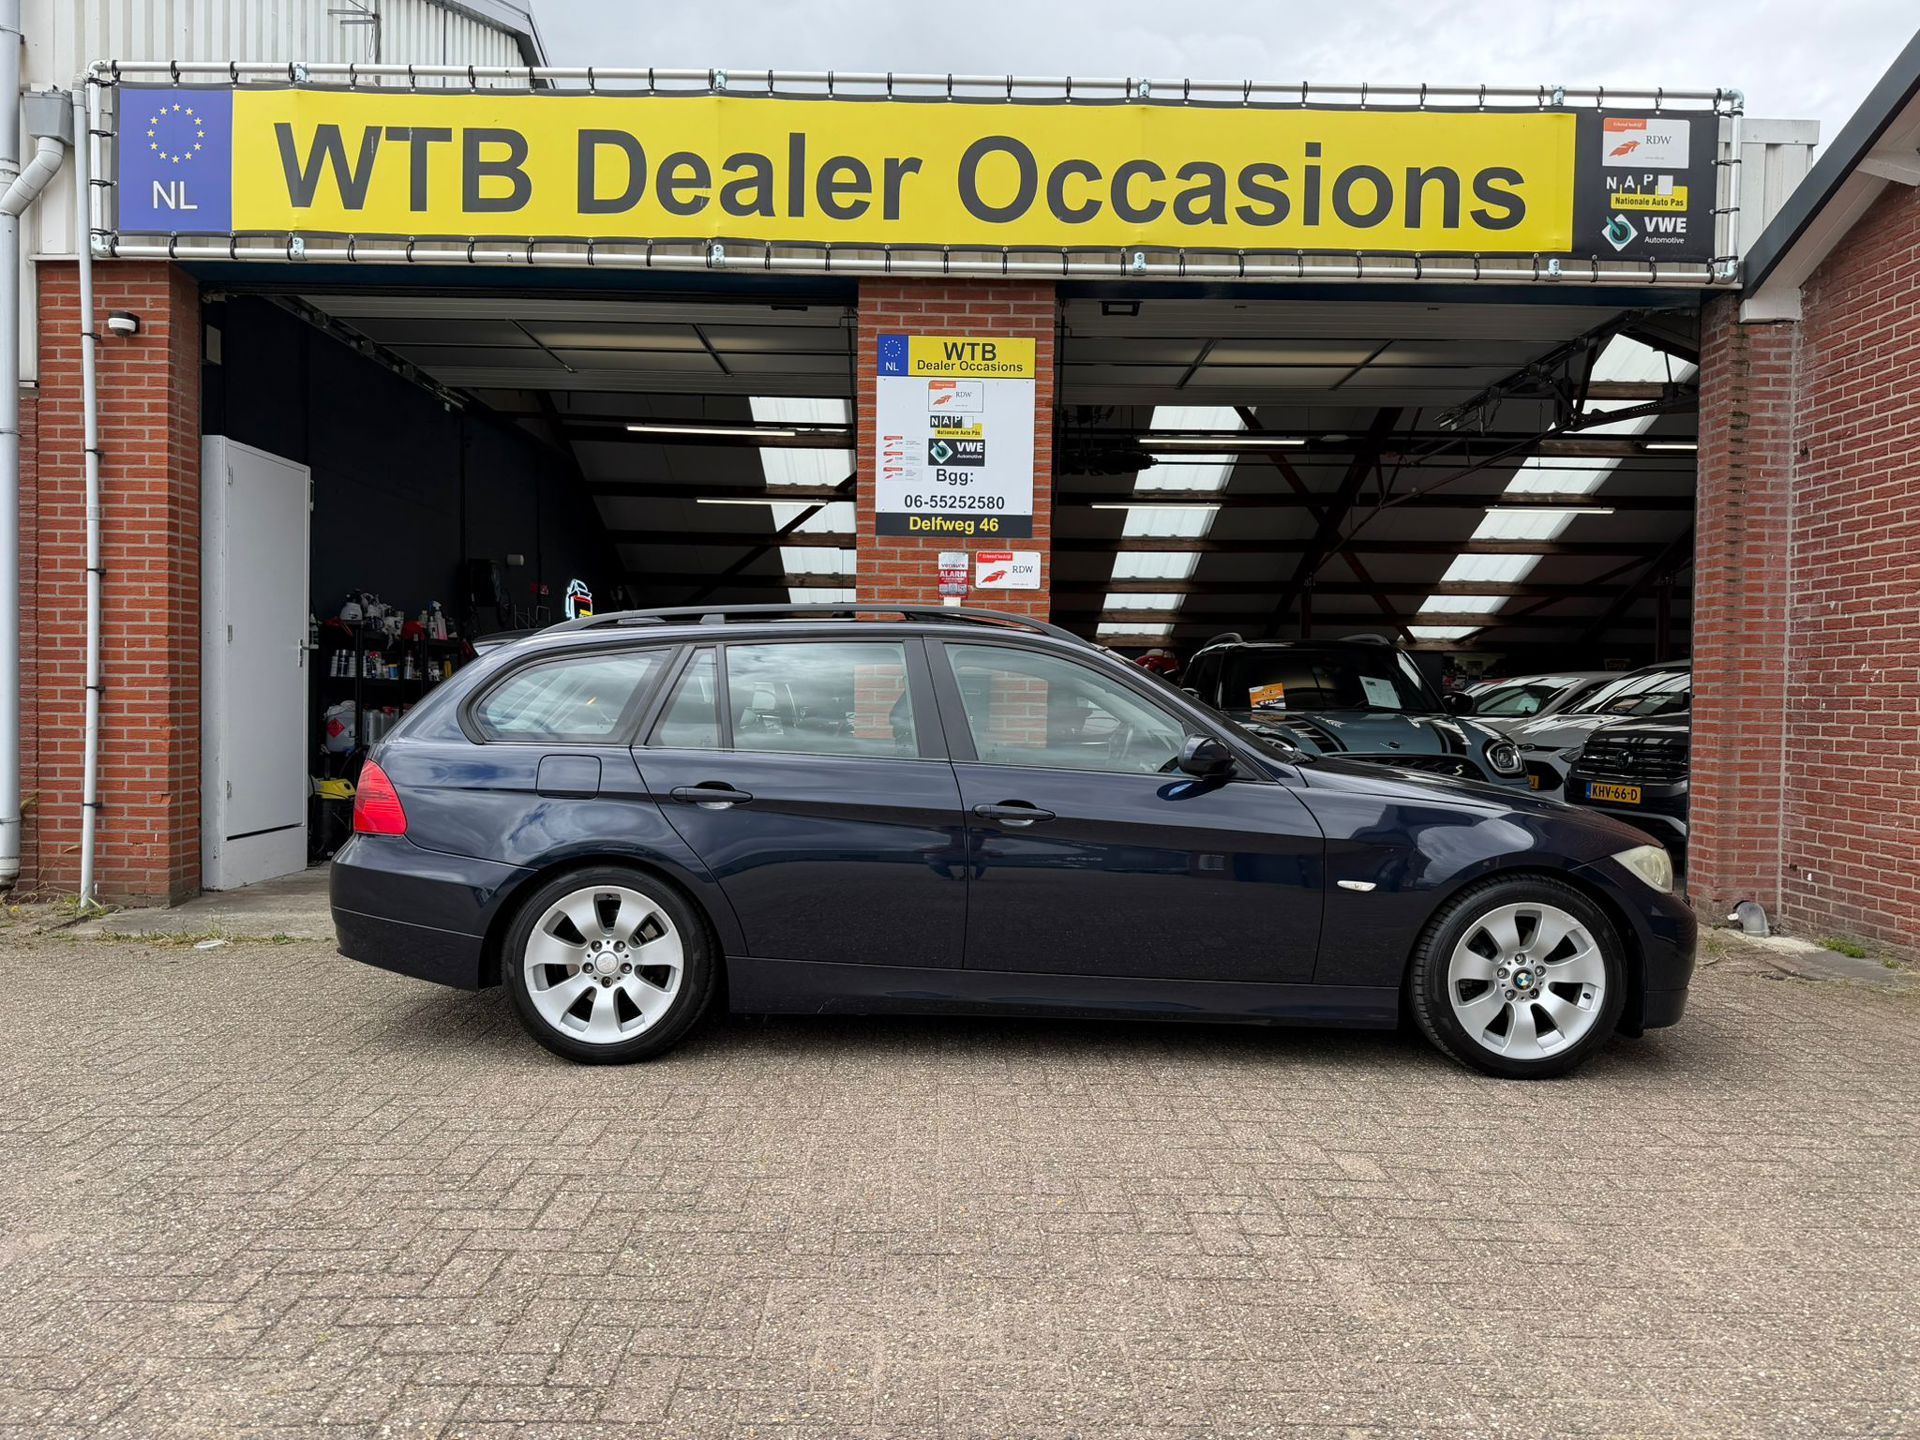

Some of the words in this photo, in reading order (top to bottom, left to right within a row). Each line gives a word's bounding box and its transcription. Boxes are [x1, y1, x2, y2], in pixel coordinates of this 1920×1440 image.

[1645, 135, 1672, 145] RDW
[274, 122, 533, 213] WTB
[577, 128, 922, 221] Dealer
[957, 134, 1527, 231] Occasions
[153, 180, 198, 210] NL
[1615, 196, 1650, 206] Nationale
[1651, 198, 1669, 207] Auto
[1670, 199, 1684, 207] Pas
[1643, 216, 1687, 233] VWE
[1644, 236, 1685, 245] Automotive
[943, 342, 998, 361] WTB
[885, 362, 900, 371] NL
[917, 360, 956, 371] Dealer
[959, 361, 1023, 373] Occasions
[955, 391, 973, 399] RDW
[956, 441, 984, 453] VWE
[936, 469, 974, 486] Bgg:
[904, 494, 1005, 510] 06-55252580
[909, 516, 976, 534] Delfweg
[979, 517, 999, 532] 46
[939, 570, 967, 578] ALARM
[1012, 565, 1034, 574] RDW
[1592, 784, 1638, 801] KHV-66-D
